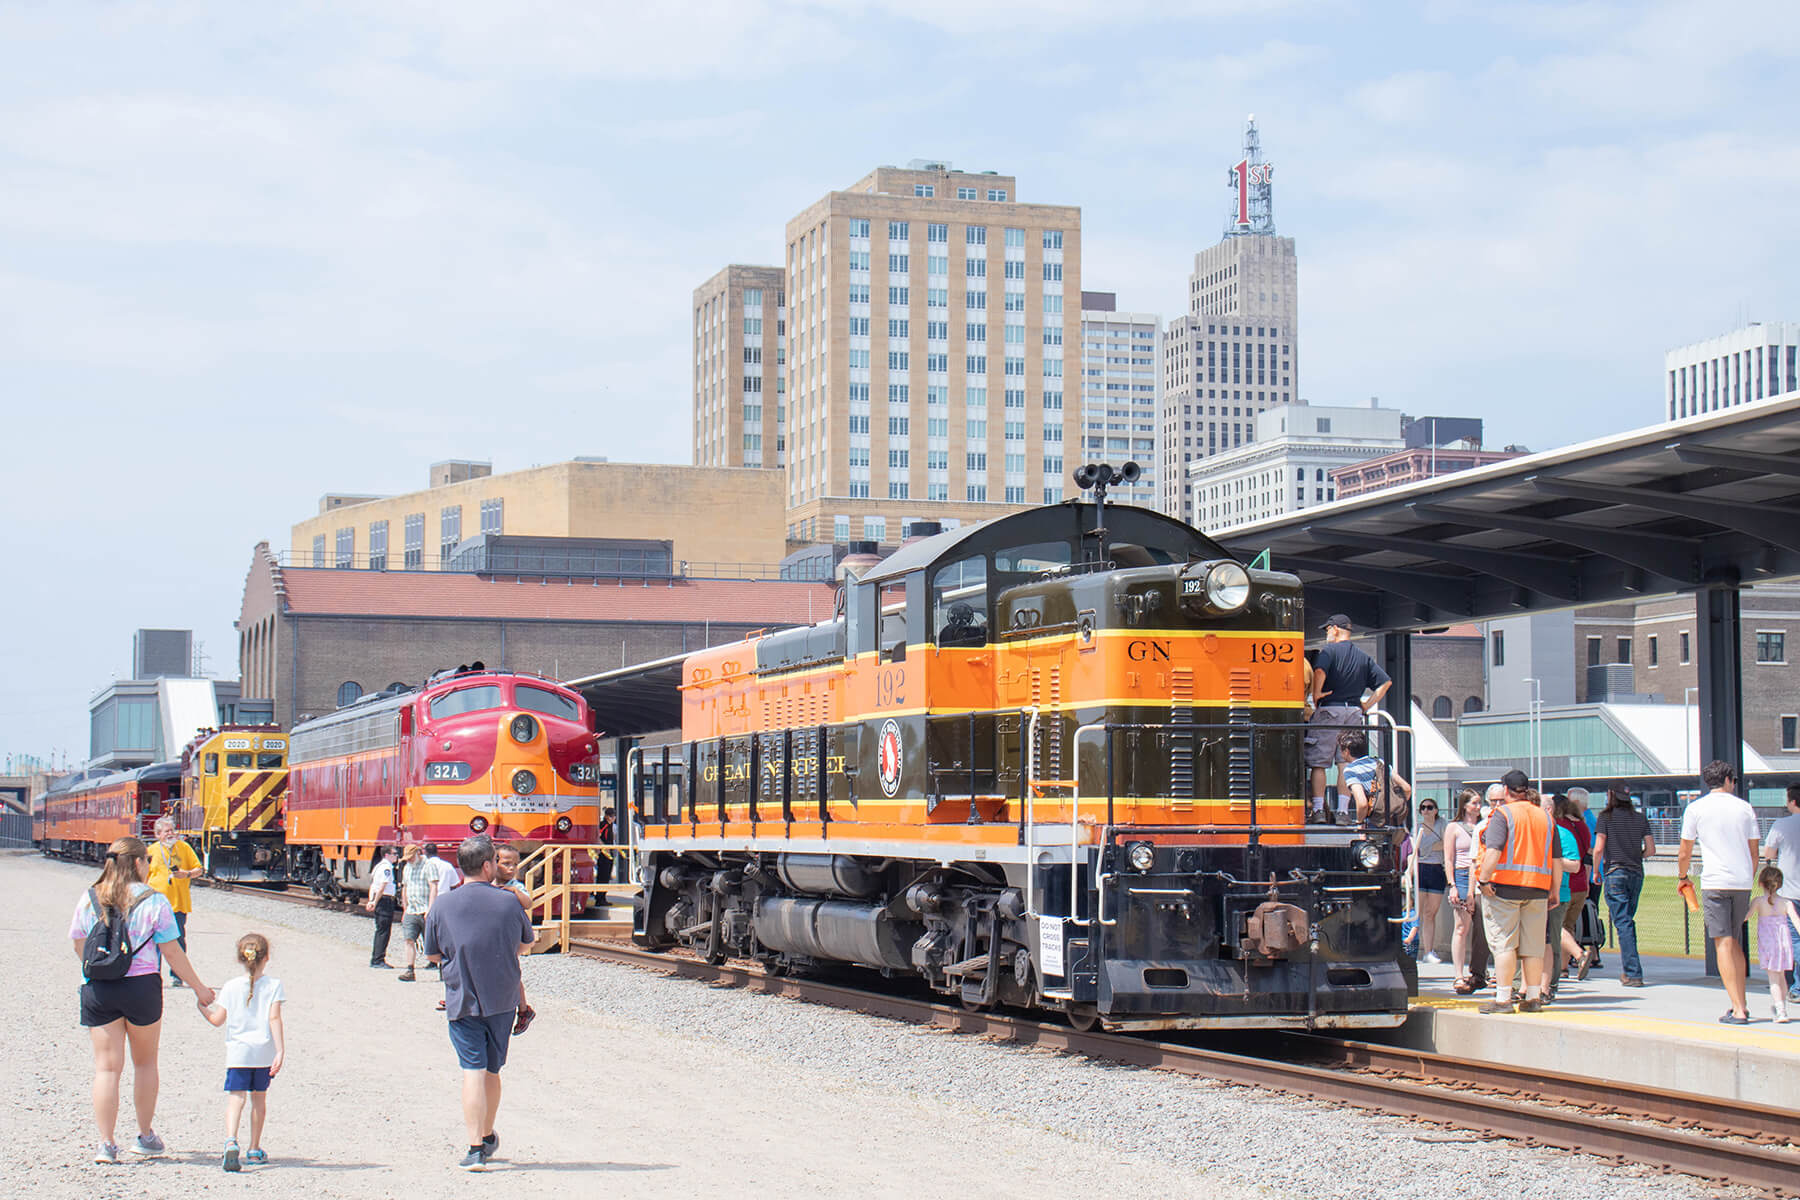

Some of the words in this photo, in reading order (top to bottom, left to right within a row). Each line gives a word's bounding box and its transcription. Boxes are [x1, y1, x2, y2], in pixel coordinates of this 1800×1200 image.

[1233, 158, 1272, 225] 1st
[1184, 580, 1201, 593] 192
[1128, 640, 1171, 662] GN
[1250, 641, 1294, 663] 192
[875, 668, 905, 707] 192
[434, 765, 459, 778] 32A
[1041, 921, 1049, 930] DO
[1050, 923, 1061, 931] NOT
